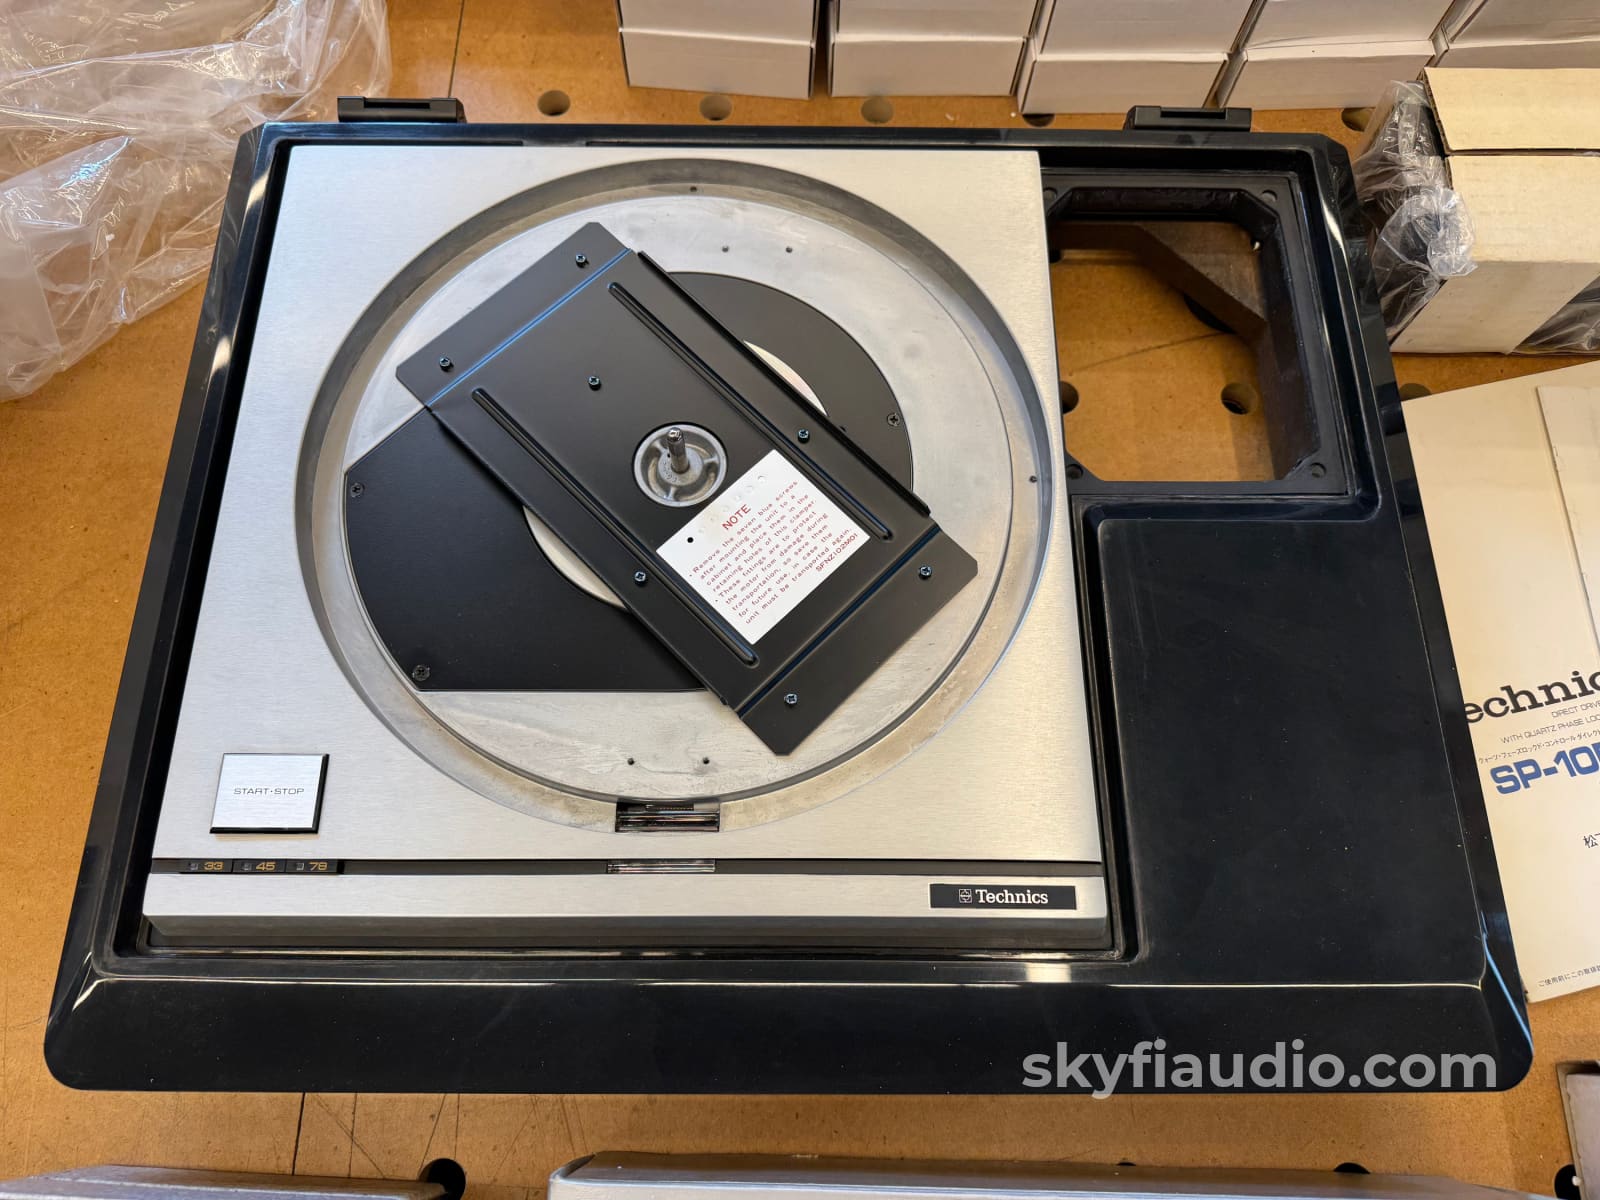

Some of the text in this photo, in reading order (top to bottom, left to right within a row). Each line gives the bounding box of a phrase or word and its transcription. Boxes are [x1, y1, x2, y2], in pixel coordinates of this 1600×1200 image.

[691, 481, 798, 573] Remove the seven blue screws
[699, 564, 716, 579] after
[718, 535, 750, 563] mounting
[749, 523, 762, 534] the
[764, 508, 778, 522] unit
[779, 500, 788, 508] to
[705, 561, 732, 586] cabinet
[733, 547, 747, 562] and
[748, 531, 767, 549] place
[768, 514, 786, 529] them
[796, 493, 808, 505] the
[721, 503, 751, 531] NOTE
[782, 557, 791, 566] so
[793, 540, 809, 556] save
[810, 524, 828, 539] them
[712, 564, 743, 592] retaining
[742, 547, 763, 564] holes
[764, 536, 772, 546] of
[773, 525, 788, 537] this
[717, 510, 816, 597] These fittings are to protect
[724, 512, 828, 605] the motor from damage during
[737, 607, 748, 617] for
[750, 586, 772, 605] future
[801, 545, 818, 560] case
[820, 532, 832, 543] the
[745, 610, 760, 624] unit
[760, 593, 779, 609] must
[778, 583, 789, 593] be
[790, 545, 830, 582] transported
[1464, 670, 1600, 724] echnic
[1551, 706, 1578, 718] DIRECT
[1500, 733, 1523, 744] WITH
[1524, 725, 1557, 738] QUARTZ
[1557, 718, 1584, 730] PHASE
[1490, 741, 1600, 795] SP-10
[203, 861, 328, 871] 33 45 78
[975, 889, 1049, 904] Technics
